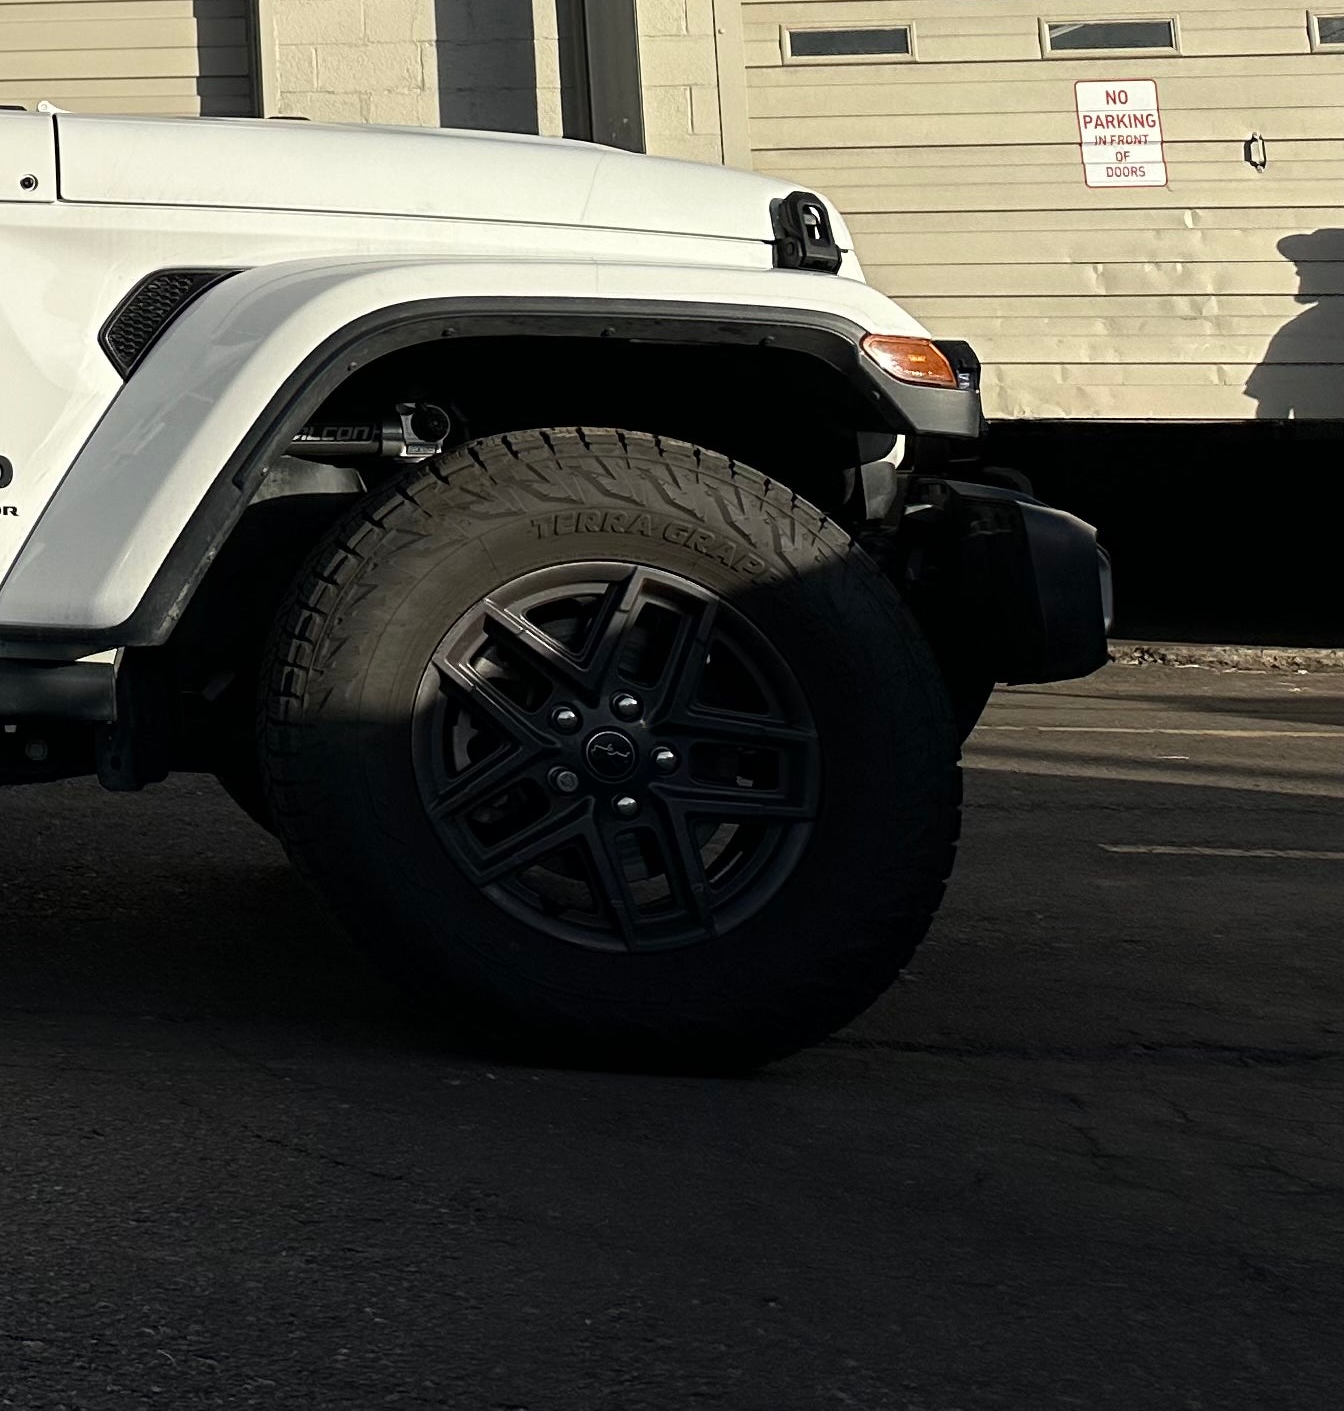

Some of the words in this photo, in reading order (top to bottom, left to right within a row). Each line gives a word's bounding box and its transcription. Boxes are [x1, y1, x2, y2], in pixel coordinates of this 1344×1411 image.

[1105, 89, 1129, 106] NO
[1082, 113, 1157, 130] PARKING
[1094, 135, 1107, 146] IN
[1110, 134, 1149, 146] FRONT
[1115, 150, 1130, 163] OF
[1105, 166, 1147, 178] DOORS
[291, 425, 369, 441] ALCON
[529, 508, 653, 541] TERRA
